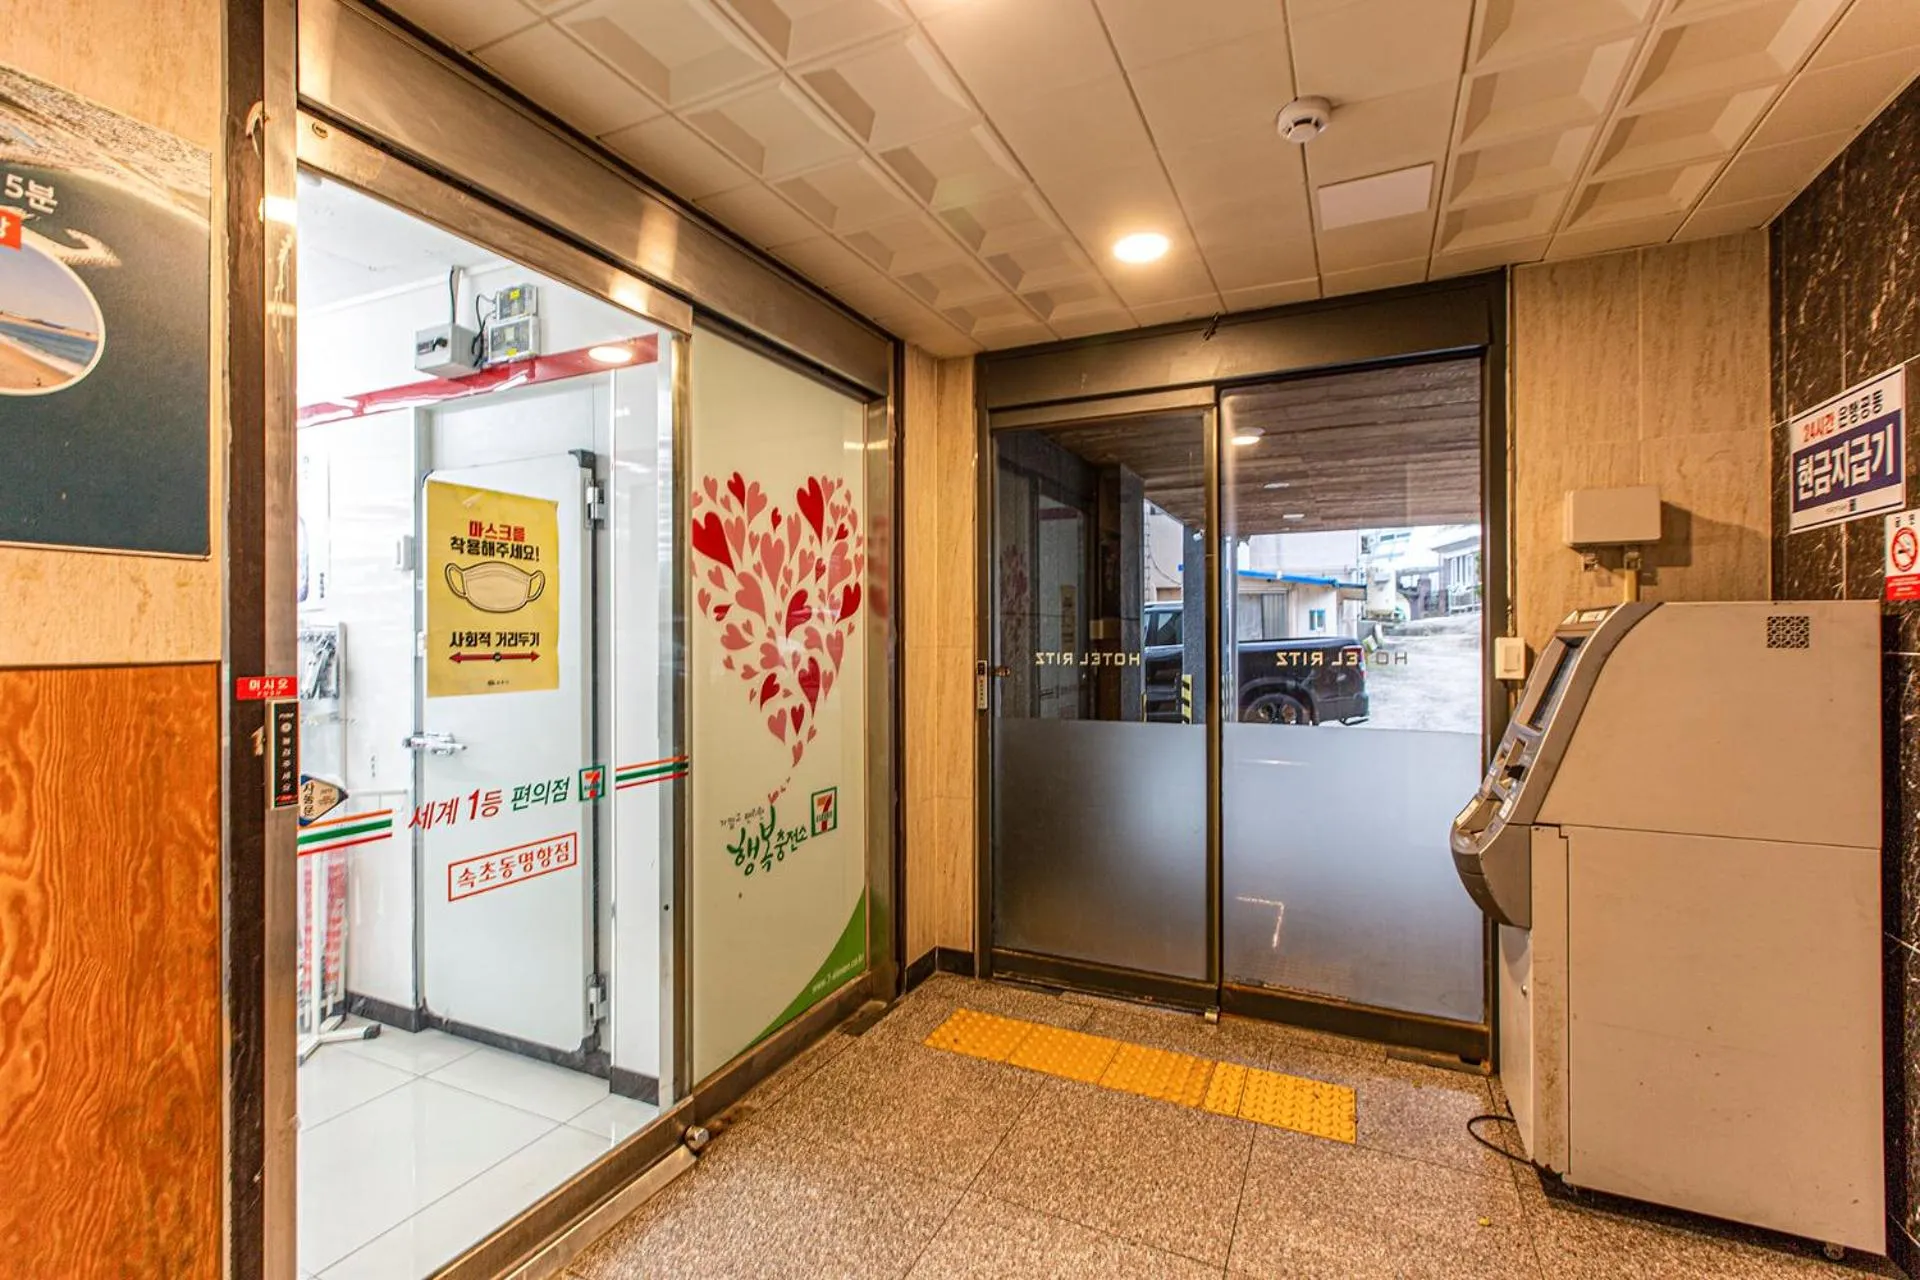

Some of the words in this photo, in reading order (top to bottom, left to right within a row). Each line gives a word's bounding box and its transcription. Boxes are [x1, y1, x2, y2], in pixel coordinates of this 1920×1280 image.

[4, 173, 58, 214] 5분
[1803, 412, 1835, 442] 24시간
[1797, 423, 1894, 501] 현금지급기
[469, 520, 525, 542] 마스크를
[450, 536, 540, 562] 착용해주세요!
[449, 631, 491, 648] 사회적
[495, 631, 540, 648] 거리두기
[249, 678, 288, 692] 미시오
[408, 797, 460, 830] 세계
[470, 788, 503, 820] 1등
[511, 776, 571, 811] 편의점
[457, 840, 571, 888] 속초동명항점
